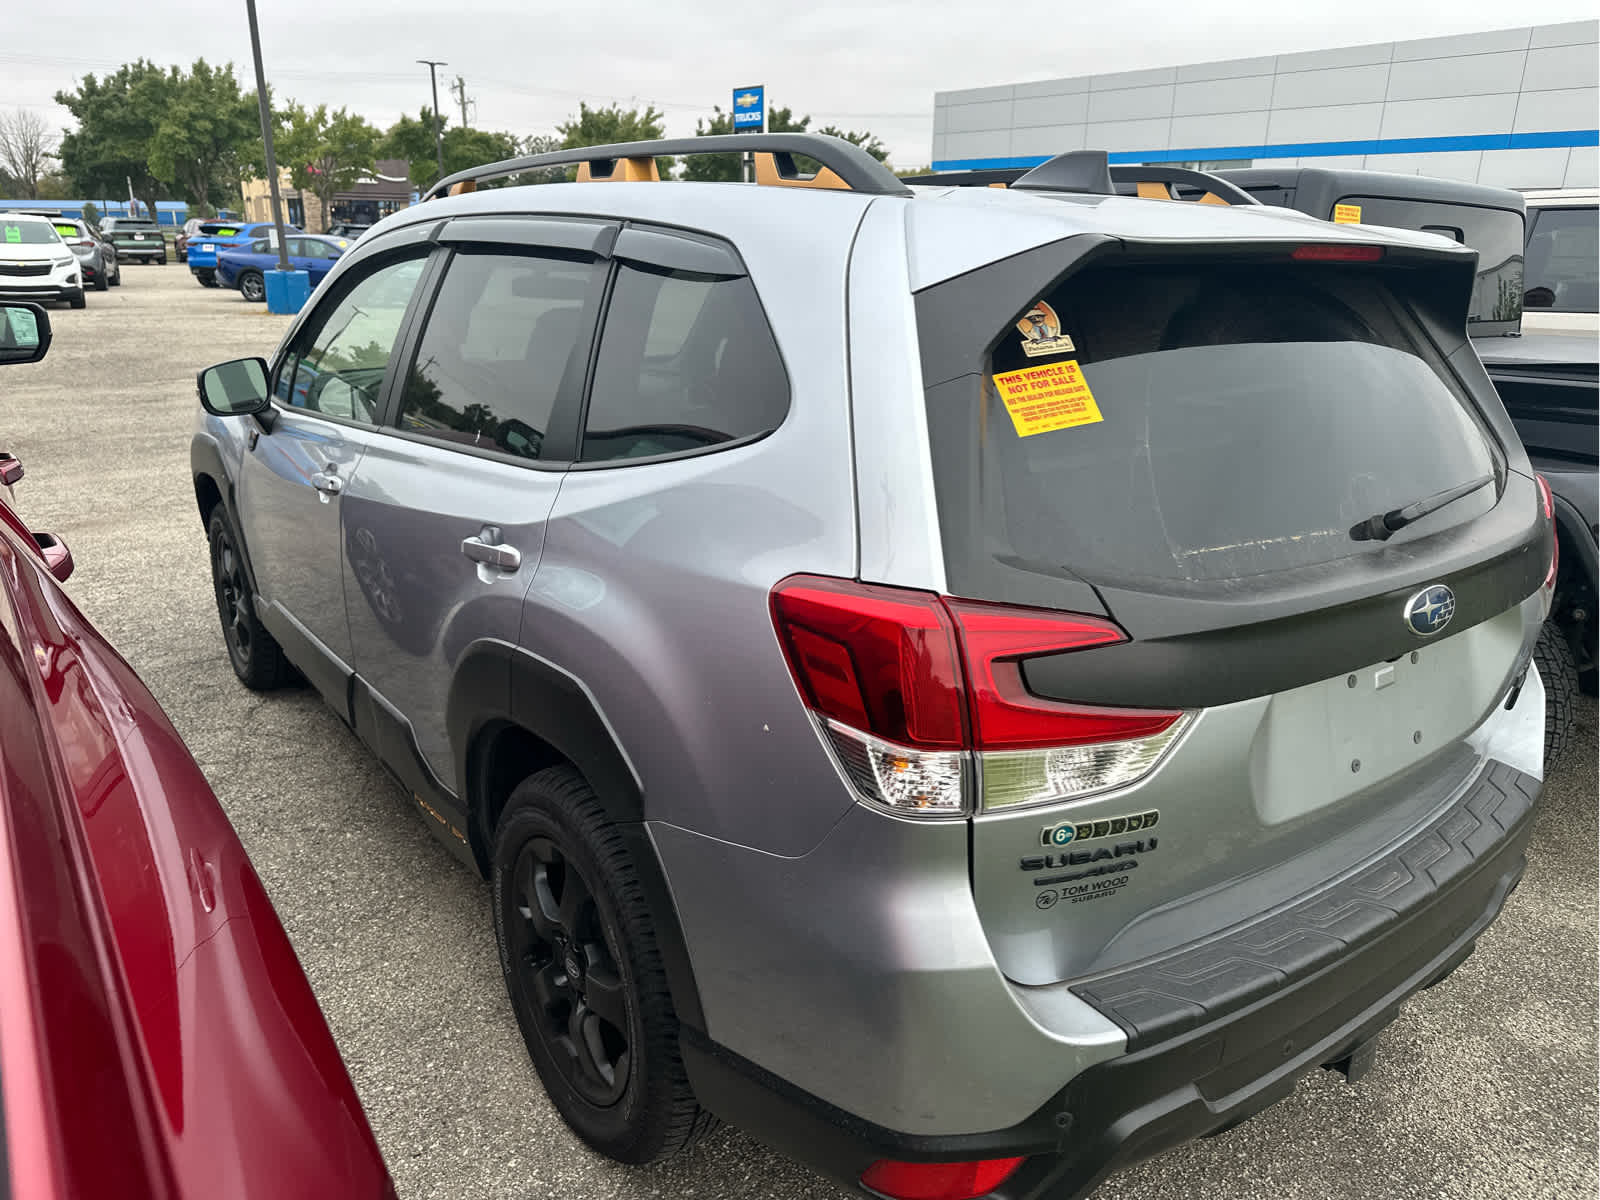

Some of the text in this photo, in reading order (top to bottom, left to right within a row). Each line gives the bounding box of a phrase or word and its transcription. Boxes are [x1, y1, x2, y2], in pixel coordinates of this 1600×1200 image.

[735, 112, 761, 122] TRUCKS
[998, 364, 1077, 385] THIS VEHICLE IS
[1007, 375, 1077, 395] NOT FOR SALE
[1020, 837, 1158, 870] SUBARU
[1062, 875, 1129, 897] TOM WOOD
[1071, 889, 1117, 904] SUBARU
